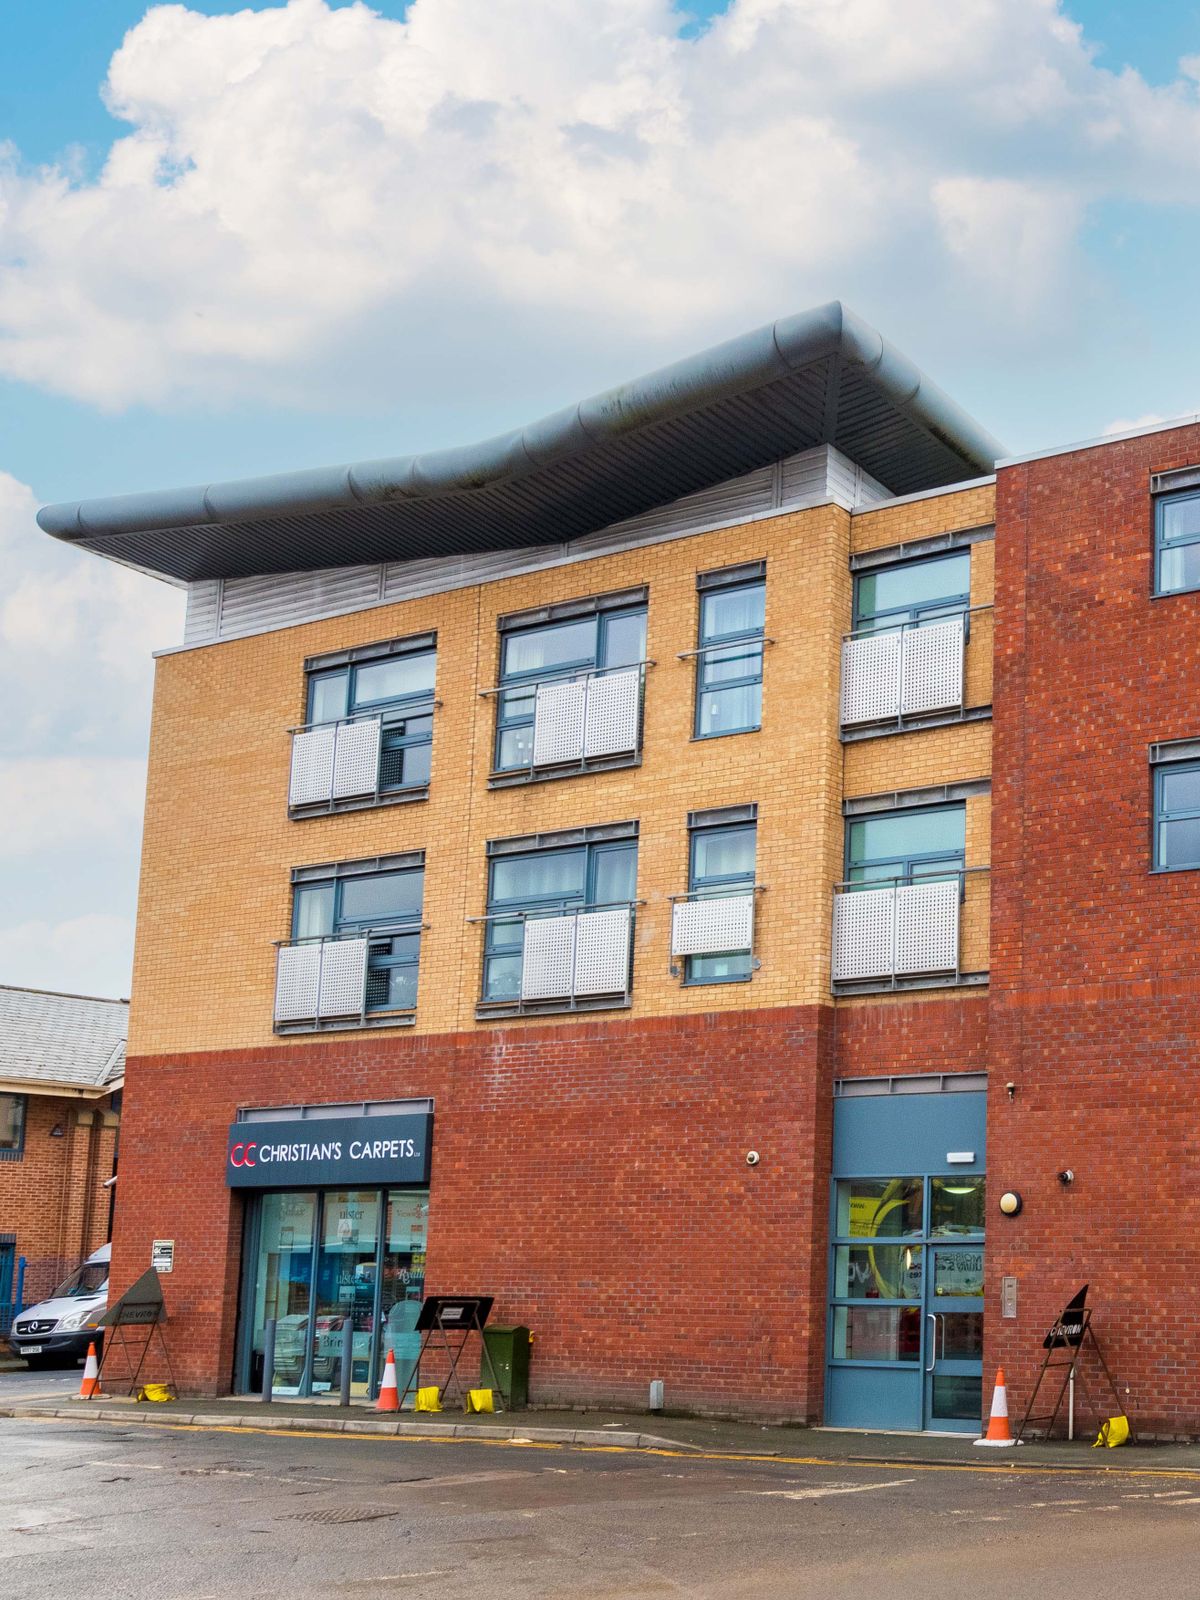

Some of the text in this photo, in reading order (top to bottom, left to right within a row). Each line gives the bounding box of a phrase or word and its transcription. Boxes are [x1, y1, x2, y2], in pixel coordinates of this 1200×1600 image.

[230, 1142, 257, 1167] CC
[259, 1142, 342, 1163] CHRISTIAN'S
[350, 1139, 414, 1159] CARPETS
